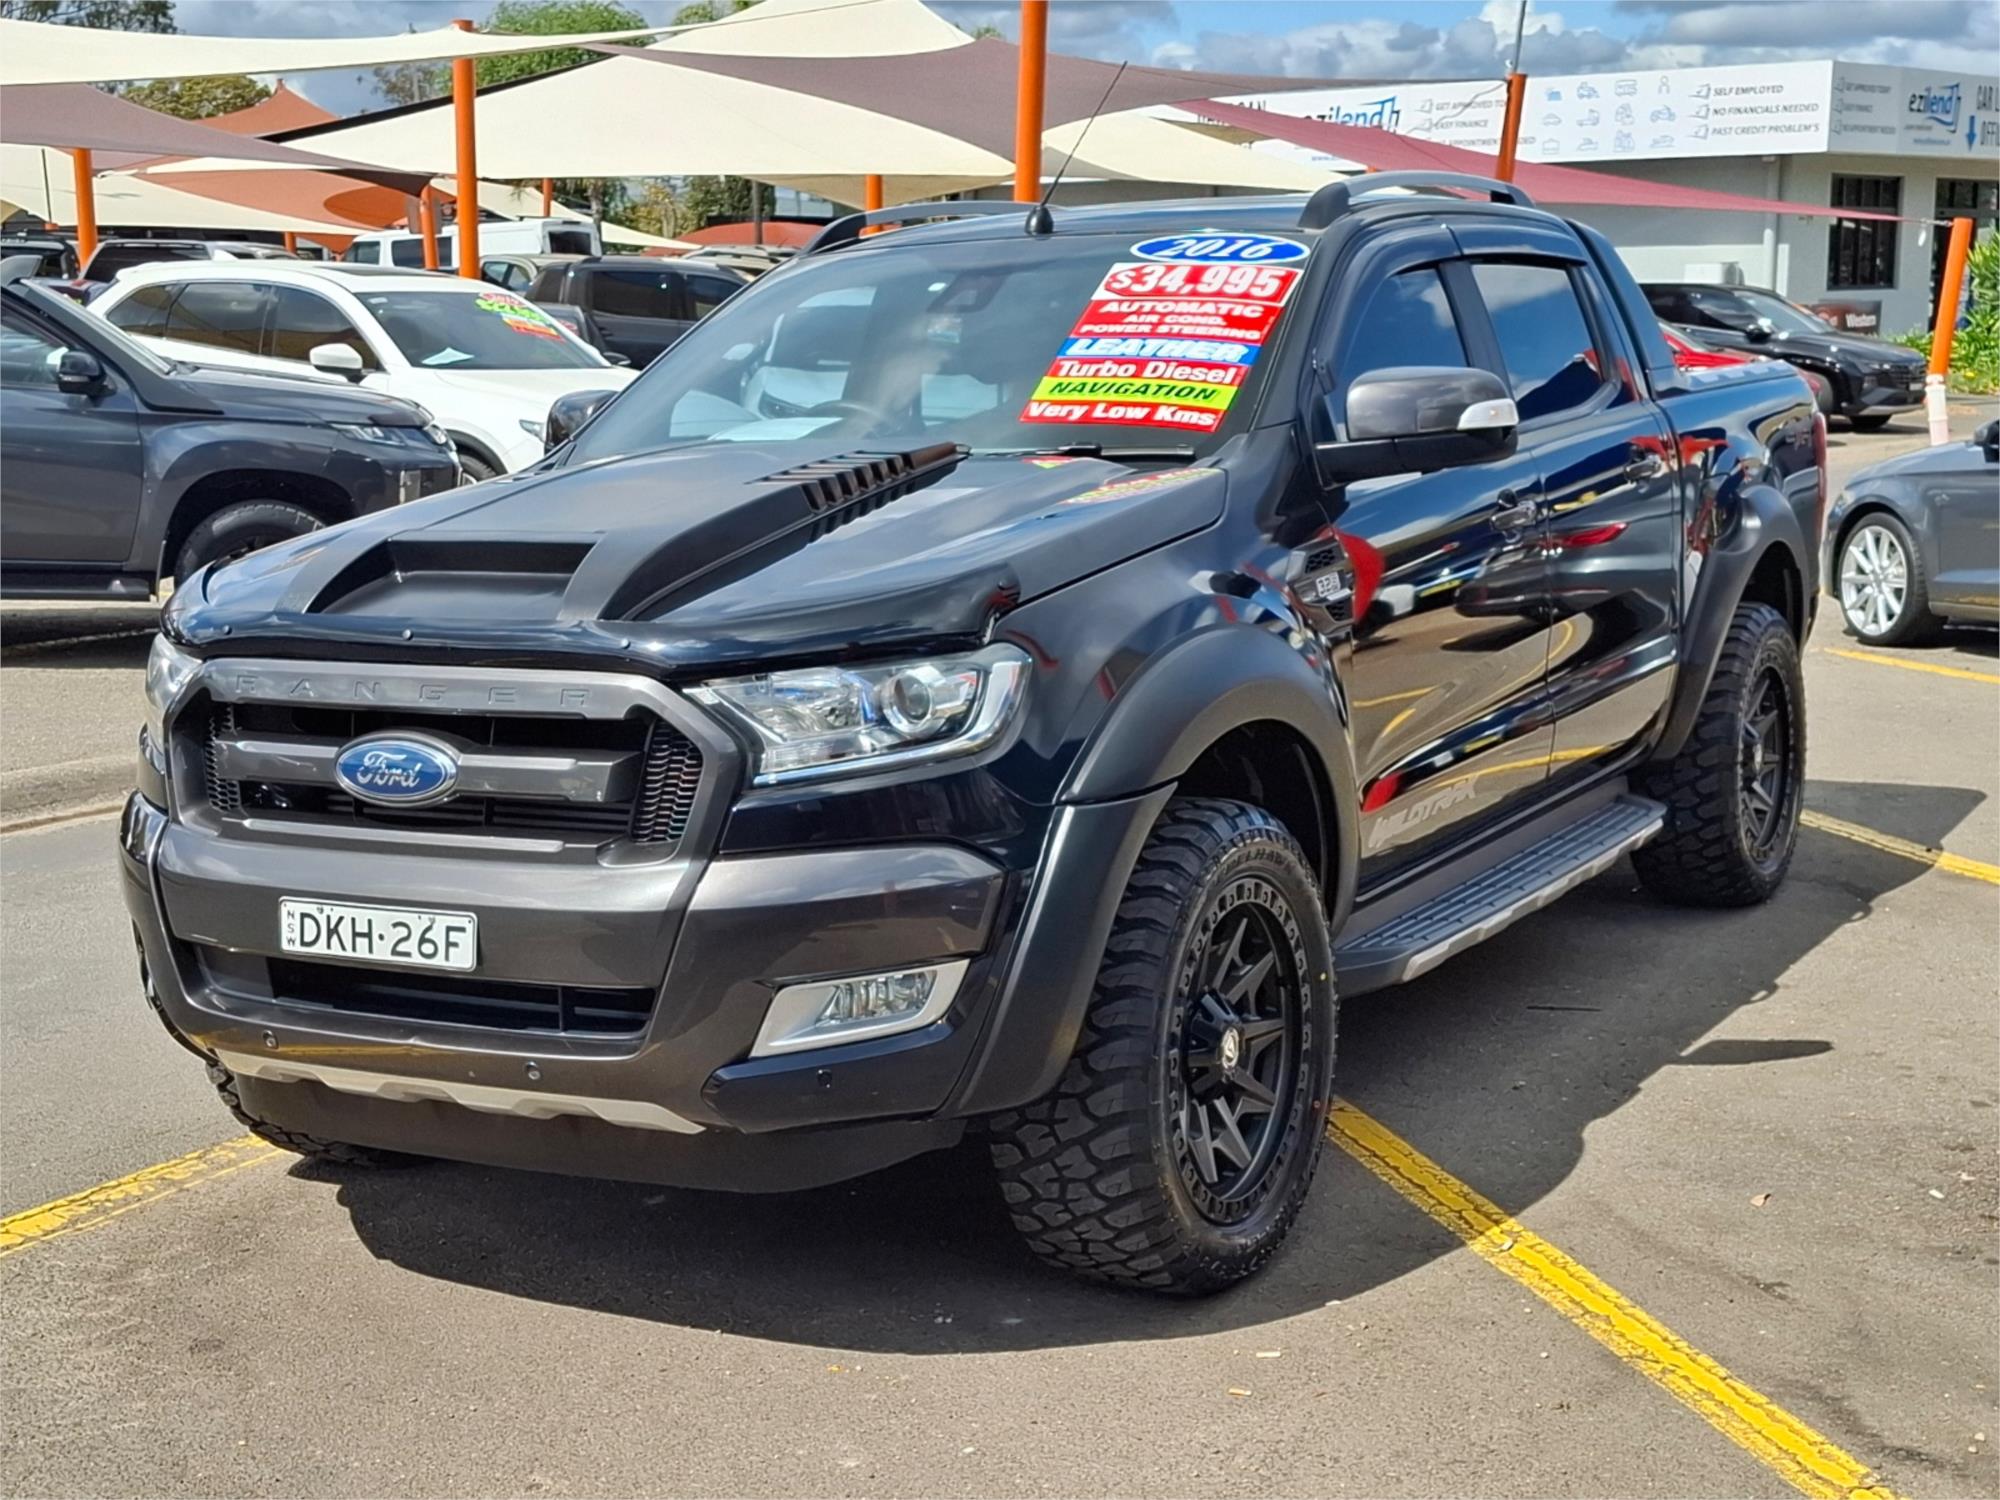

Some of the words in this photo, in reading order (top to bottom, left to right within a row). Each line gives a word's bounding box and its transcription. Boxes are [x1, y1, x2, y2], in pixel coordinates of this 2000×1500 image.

[1713, 87, 1734, 96] SELF
[1735, 84, 1784, 95] EMPLOYED
[1712, 108, 1726, 117] NO
[1727, 104, 1780, 115] FINANCIALS
[1781, 103, 1819, 113] NEEDED
[1711, 126, 1733, 136] PAST
[1734, 124, 1767, 135] CREDIT
[1153, 239, 1273, 258] 2016
[1109, 265, 1286, 297] $34,995
[1100, 302, 1264, 317] AUTOMATIC
[1122, 314, 1160, 323] AIR
[1164, 315, 1227, 326] COND.
[1079, 324, 1152, 333] POWER
[1155, 324, 1261, 341] STEERING
[1065, 338, 1249, 361] LEATHER
[1057, 360, 1137, 378] Turbo
[1142, 361, 1238, 384] Diesel
[1049, 381, 1218, 400] NAVIGATION
[1027, 402, 1089, 421] Very
[1092, 404, 1151, 419] Low
[1153, 408, 1215, 426] Kms
[235, 674, 592, 707] RANGER
[356, 751, 421, 789] Ford
[1367, 774, 1479, 849] WILDTRAK
